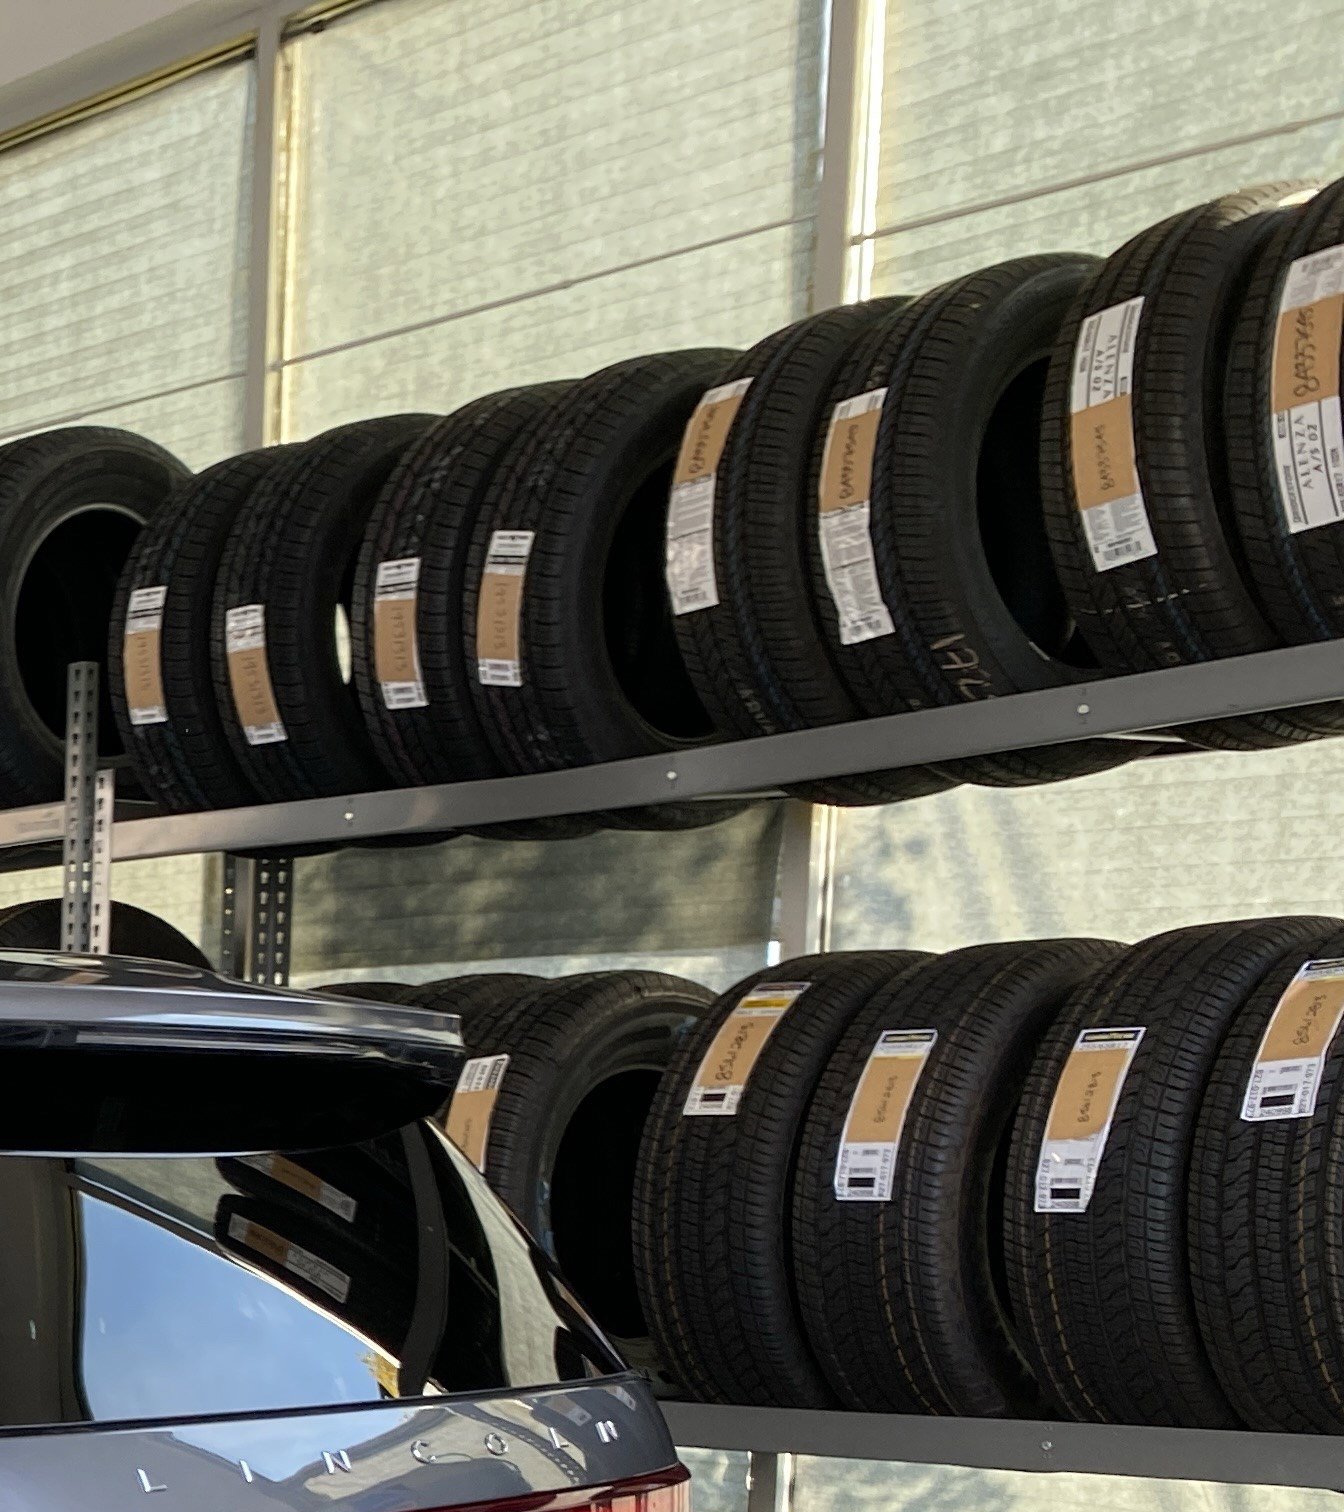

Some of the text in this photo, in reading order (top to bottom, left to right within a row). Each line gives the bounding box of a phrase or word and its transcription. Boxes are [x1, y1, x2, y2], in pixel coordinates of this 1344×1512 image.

[1293, 414, 1314, 489] ALENZA
[1306, 423, 1324, 473] A/S 02
